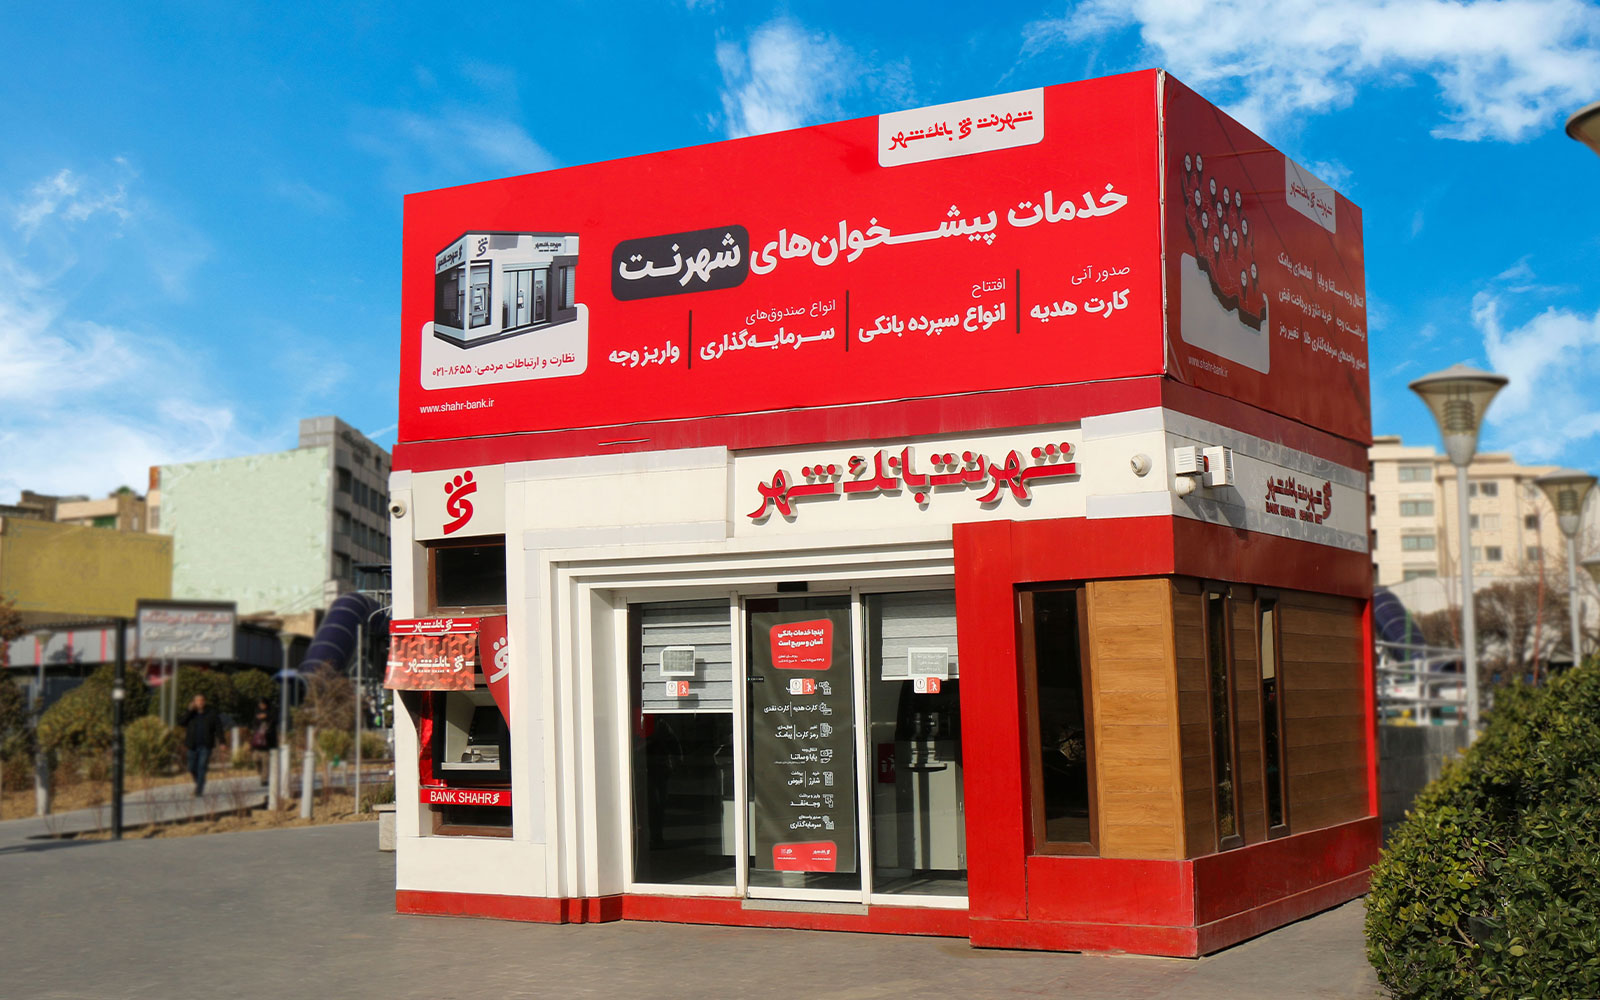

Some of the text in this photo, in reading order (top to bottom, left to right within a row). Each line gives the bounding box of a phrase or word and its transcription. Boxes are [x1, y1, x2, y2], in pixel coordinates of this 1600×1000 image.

[1007, 183, 1128, 227] خدمات
[618, 232, 742, 286] شهرنت
[1070, 265, 1130, 285] صدور آنی
[971, 278, 1006, 298] افتتاح
[810, 299, 836, 318] انواع
[1030, 288, 1130, 323] کارت هدیه
[858, 303, 1006, 343] انواع سپرده بانکی
[550, 353, 575, 367] نظارت
[608, 341, 680, 368] واریز وجه
[505, 356, 539, 371] ارتباطات
[541, 358, 547, 369] و
[419, 398, 495, 414] www.shahr-bank.ir
[777, 630, 793, 638] بانکی
[809, 638, 823, 646] آسان
[777, 704, 790, 713] کارت
[805, 704, 818, 712] کارت
[796, 731, 809, 739] کارت
[430, 791, 492, 804] BANK SHAHR
